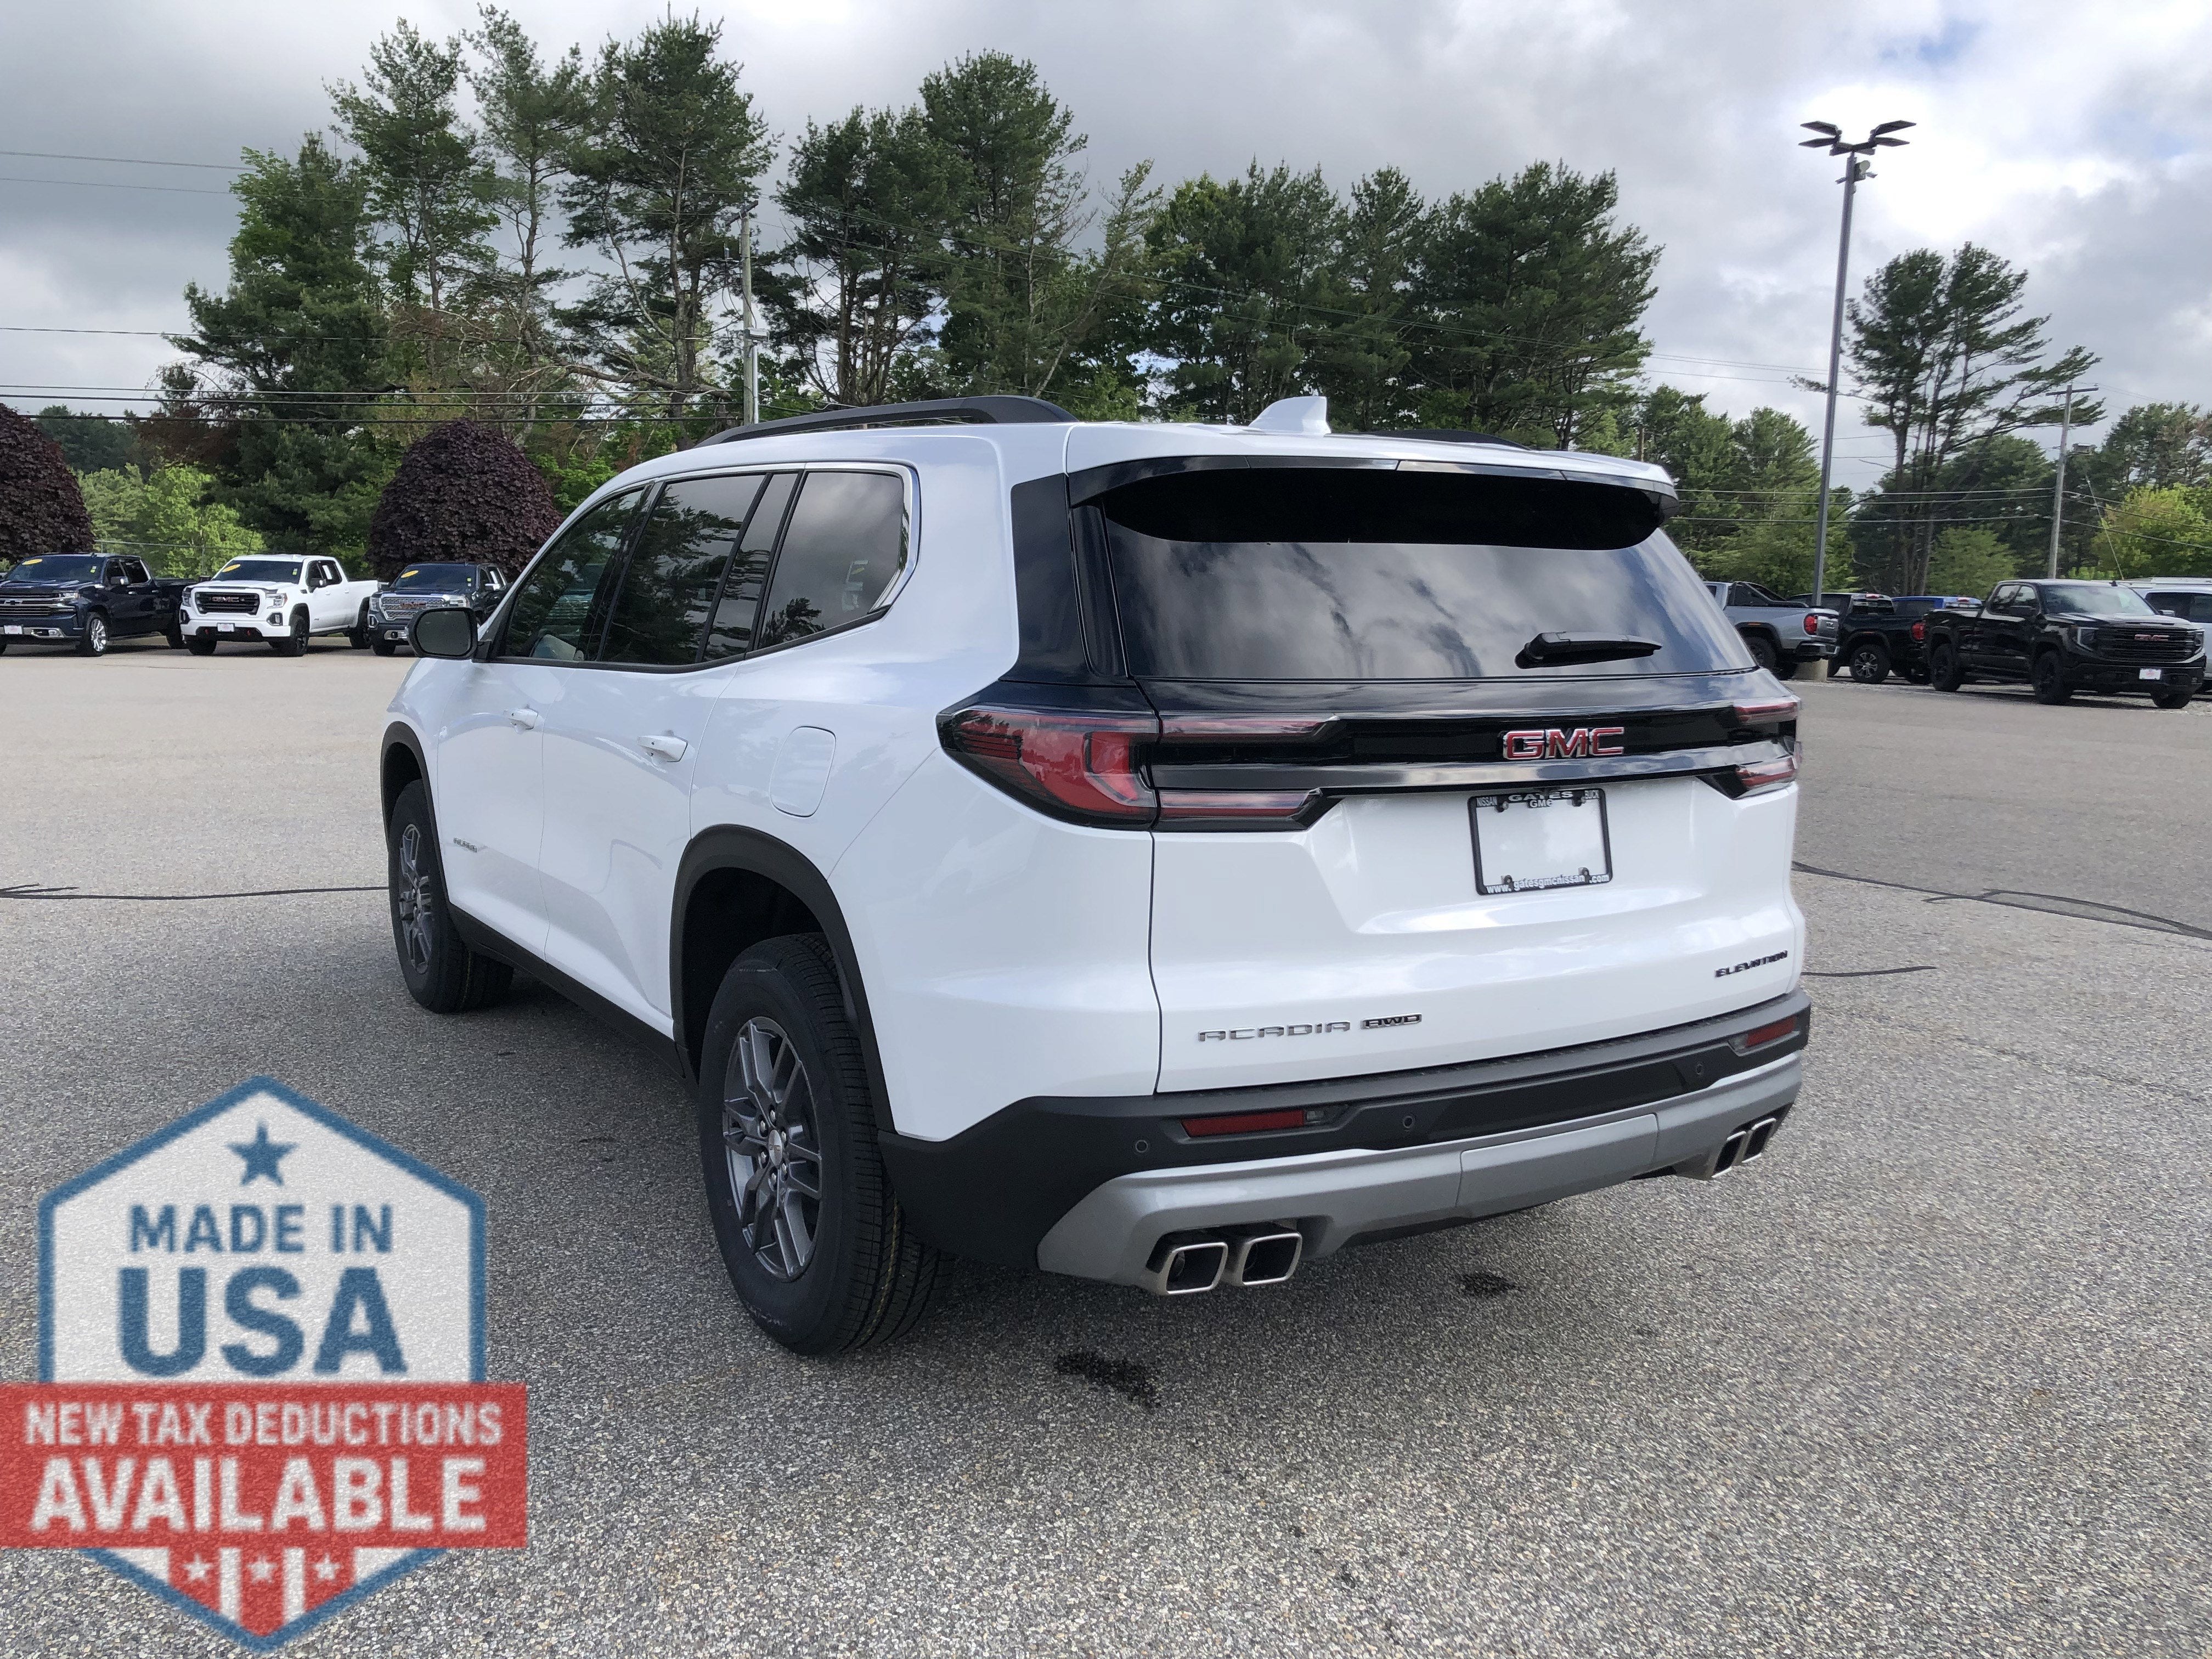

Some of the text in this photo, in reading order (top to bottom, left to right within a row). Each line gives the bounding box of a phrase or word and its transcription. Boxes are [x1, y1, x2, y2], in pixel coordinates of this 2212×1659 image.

[1503, 727, 1624, 759] GMC
[1508, 791, 1573, 801] GATES
[1530, 799, 1552, 808] GMC
[1198, 1013, 1421, 1042] ACADIA AWD
